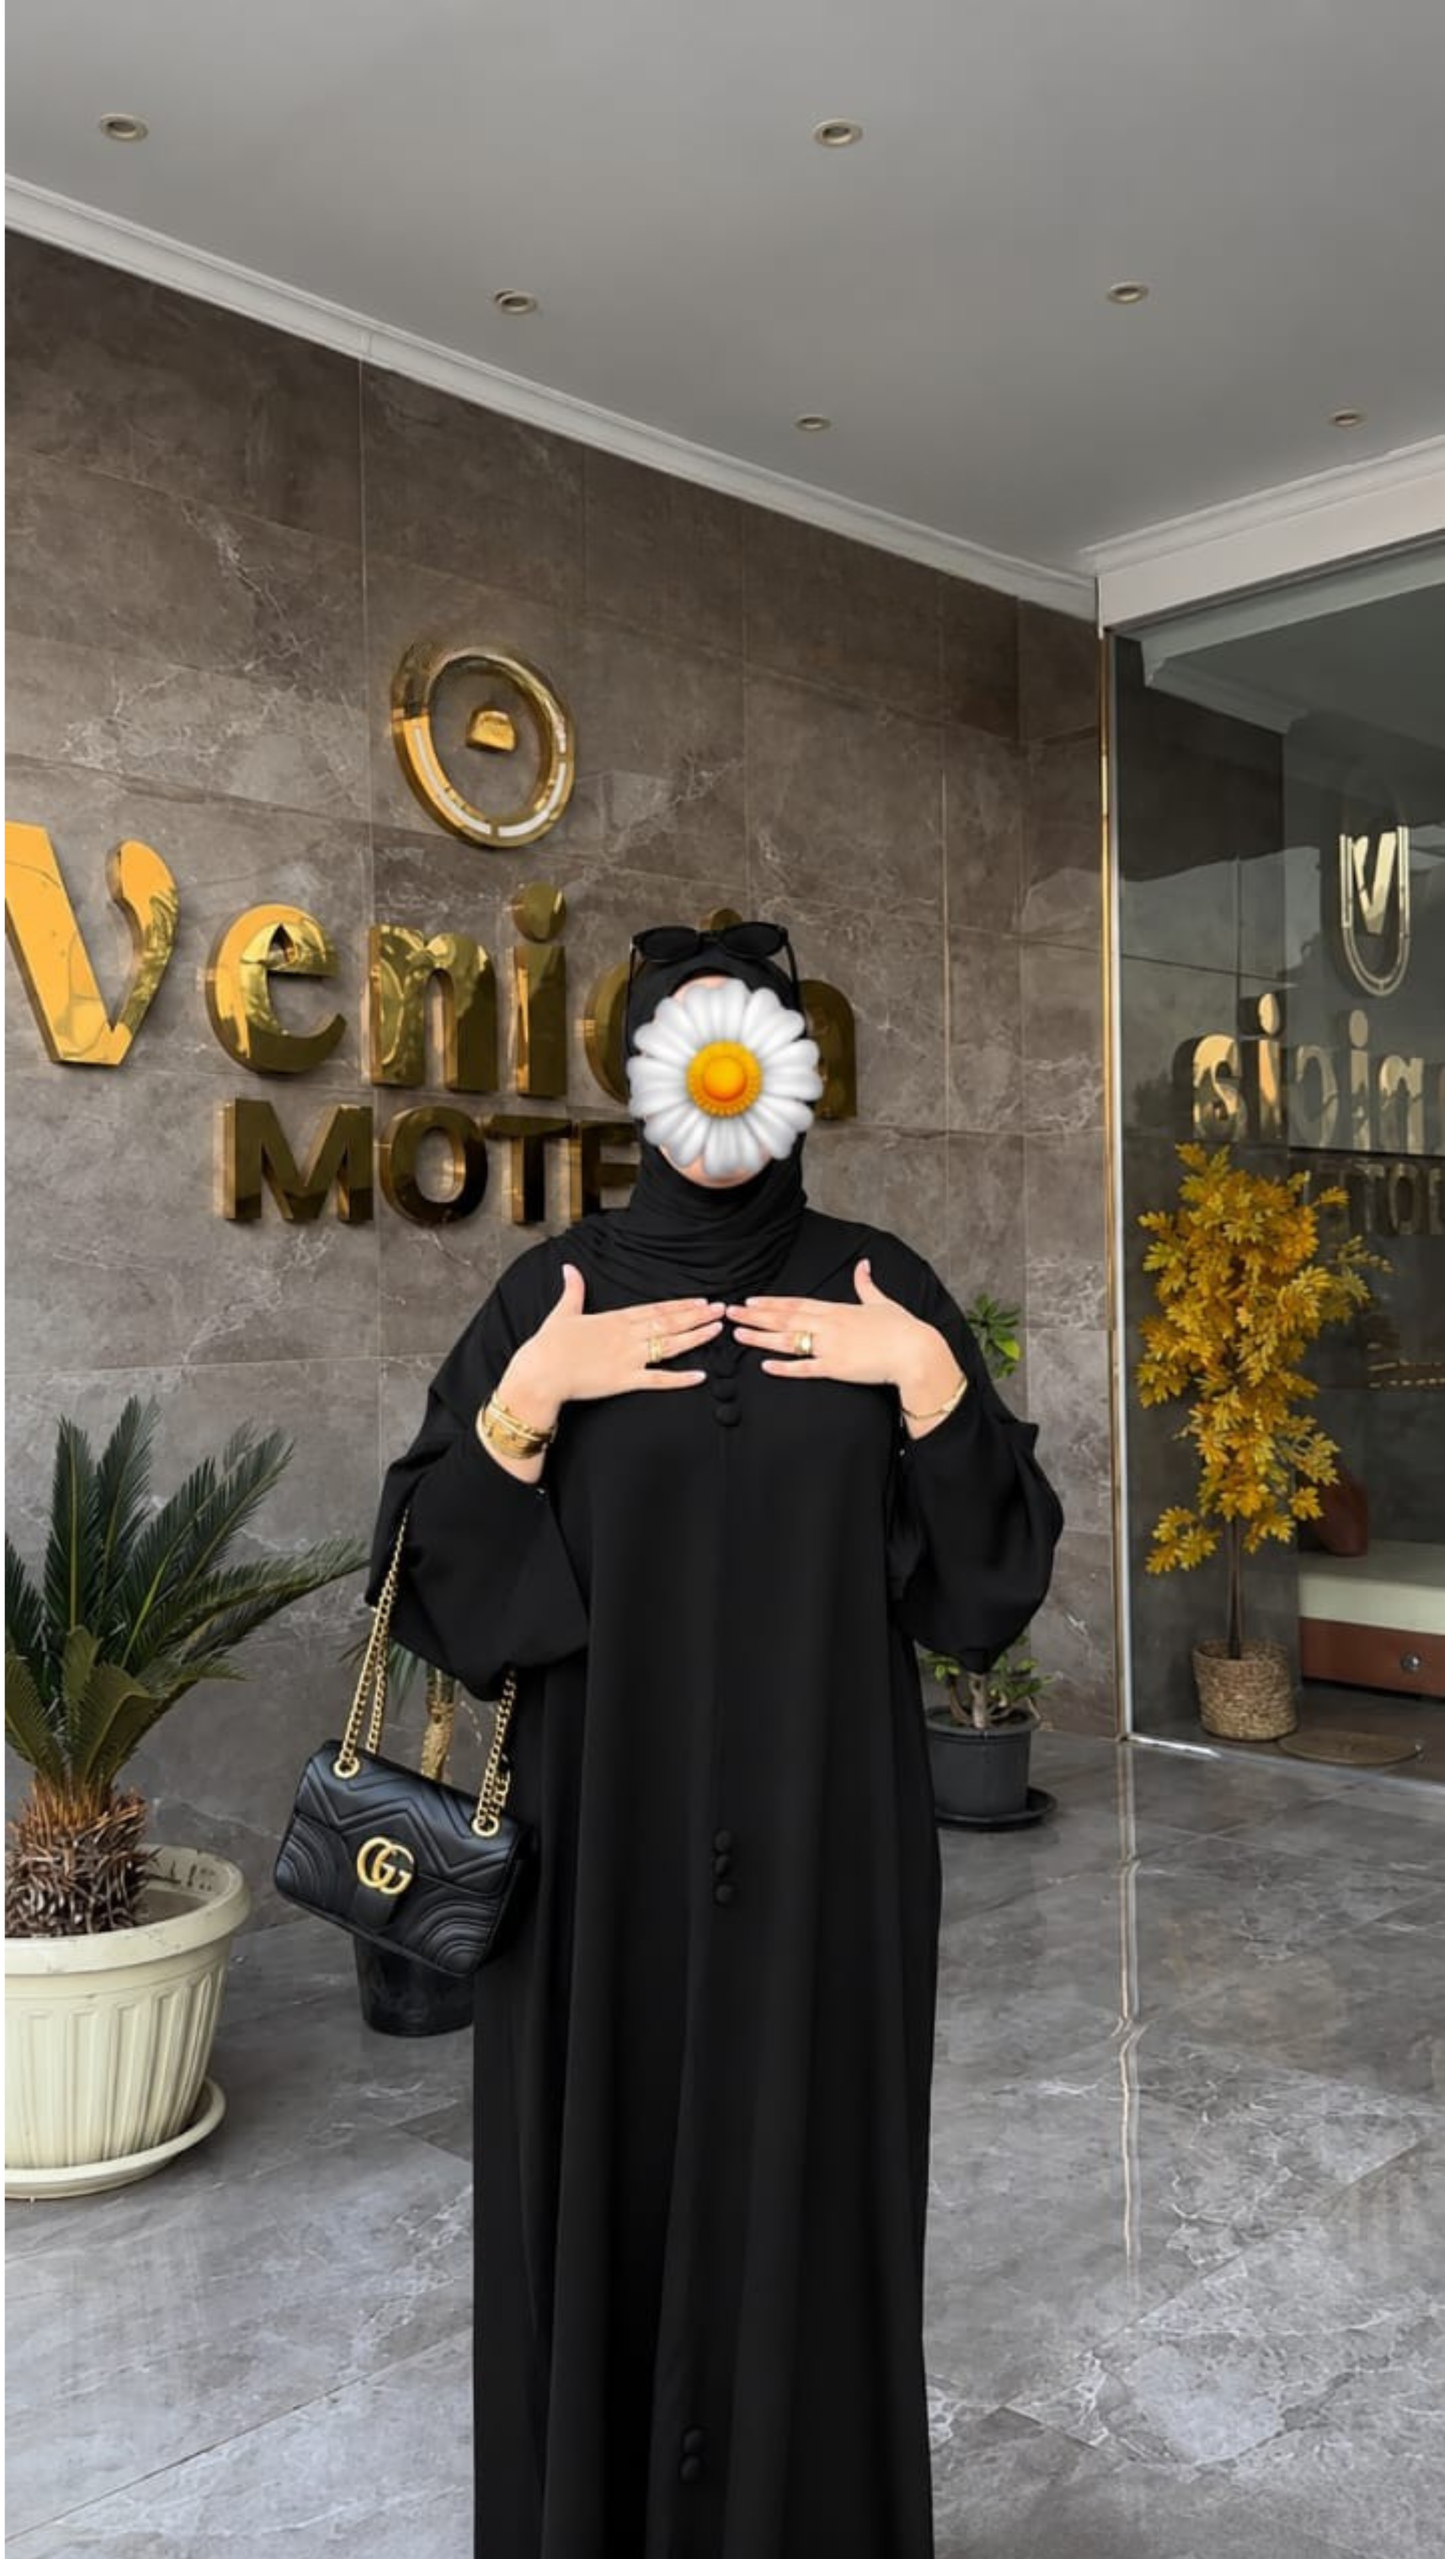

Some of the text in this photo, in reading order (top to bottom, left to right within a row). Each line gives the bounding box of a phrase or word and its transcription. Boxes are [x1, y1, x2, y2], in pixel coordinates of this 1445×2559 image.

[5, 819, 858, 1120] Veni
[222, 1097, 640, 1225] MOTE
[356, 1836, 415, 1895] GG
